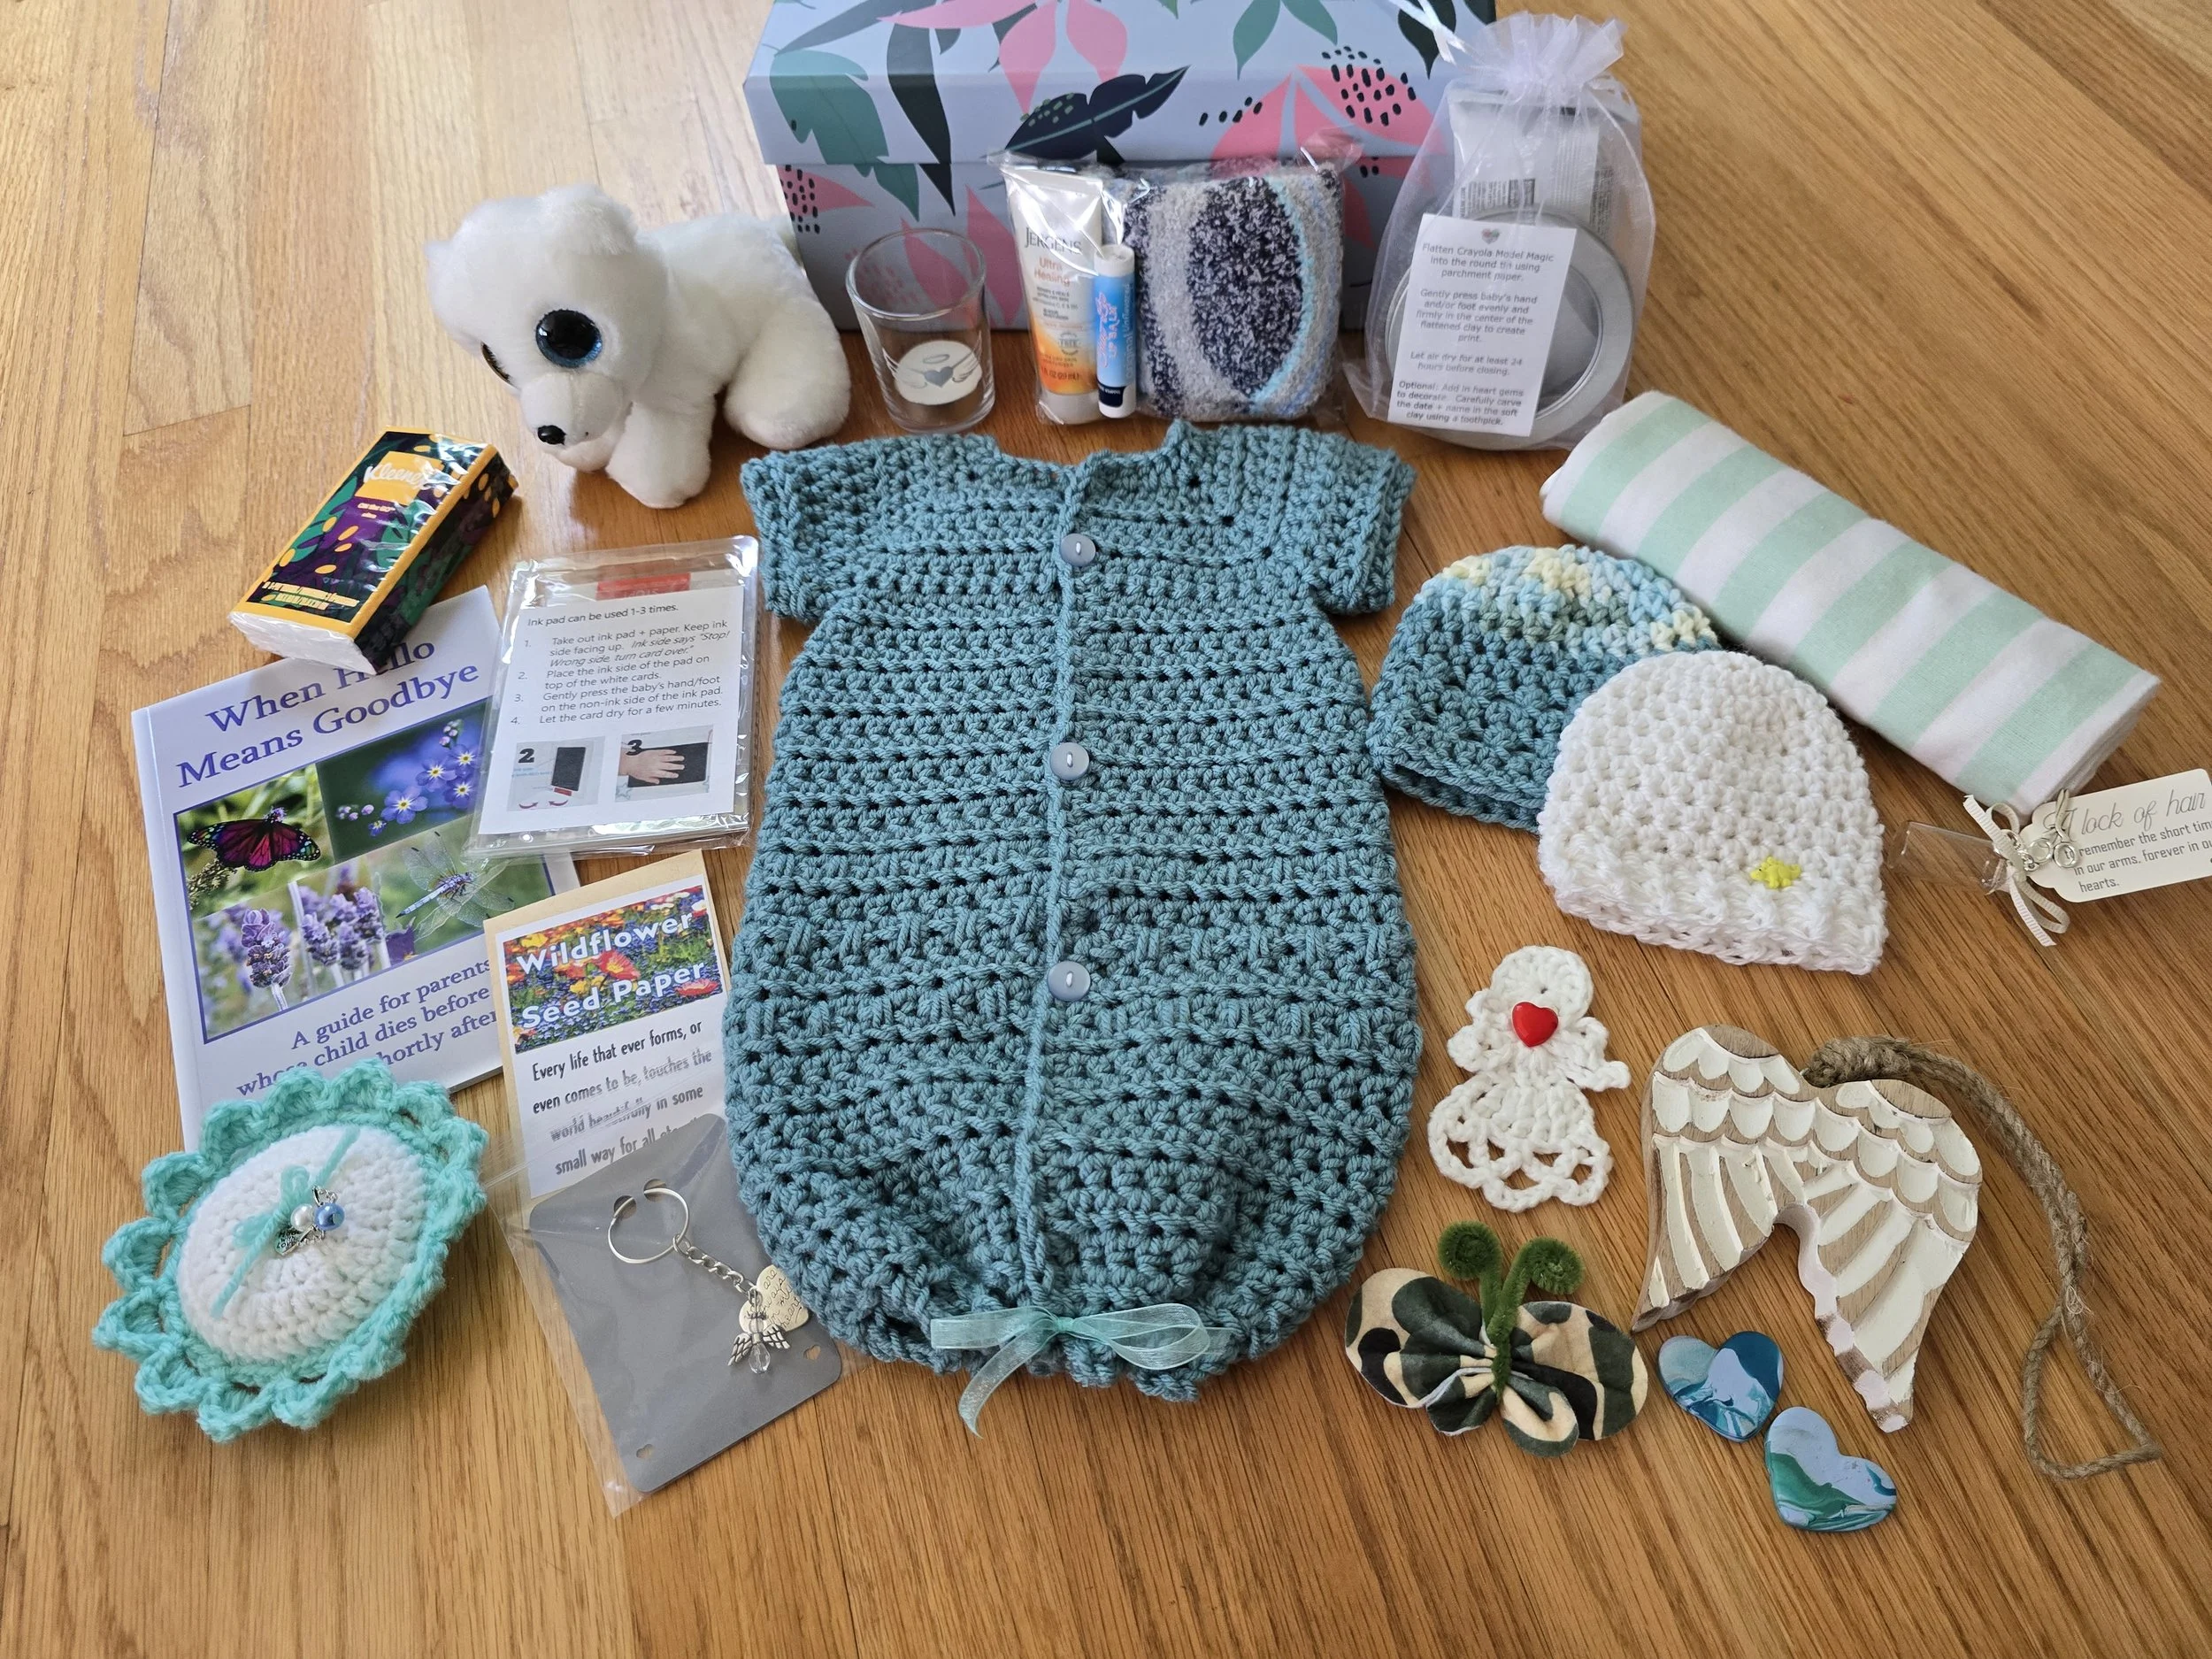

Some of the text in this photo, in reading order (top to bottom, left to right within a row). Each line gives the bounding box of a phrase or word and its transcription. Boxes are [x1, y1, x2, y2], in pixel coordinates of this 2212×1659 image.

[1422, 243, 1554, 263] Flatten Crayola Magic
[1441, 269, 1491, 280] parchment
[1516, 264, 1540, 273] using
[1420, 289, 1538, 304] Gently press hand
[1479, 304, 1509, 313] evenly
[1421, 320, 1525, 334] flattened clay create
[1417, 362, 1509, 376] hours before closing.
[1486, 356, 1508, 365] least
[1399, 380, 1439, 391] Optional:
[1473, 385, 1497, 395] heart
[1414, 402, 1432, 411] date
[1455, 395, 1494, 405] Carefully
[1407, 411, 1503, 426] clay using toothpick.
[527, 617, 543, 626] Ink
[546, 615, 566, 626] pad
[568, 614, 586, 623] can
[604, 609, 628, 618] used
[631, 607, 647, 616] 1-3
[649, 604, 679, 613] times.
[552, 635, 575, 645] Take
[578, 634, 595, 644] out
[597, 632, 613, 641] ink
[616, 630, 635, 641] pad
[649, 626, 681, 637] paper.
[684, 623, 710, 633] Keep
[549, 635, 695, 657] side facing Ink says
[547, 670, 574, 679] Place
[578, 667, 595, 676] the
[597, 665, 612, 674] ink
[616, 664, 637, 672] side
[654, 659, 670, 669] the
[672, 657, 693, 667] pad
[550, 649, 664, 668] Wrong card
[205, 641, 434, 732] When Hllo
[543, 676, 720, 702] Gently press the baby's hand/foot
[545, 682, 564, 691] top
[580, 678, 595, 687] the
[600, 675, 629, 685] white
[631, 672, 661, 682] cards.
[559, 703, 576, 711] the
[580, 699, 619, 709] non-ink
[624, 696, 645, 705] side
[682, 689, 697, 699] ink
[701, 687, 723, 699] pad.
[540, 699, 721, 724] Let the card dry for few minutes.
[175, 665, 480, 787] Means Goodbye
[518, 749, 534, 763] 2
[626, 740, 642, 756] 3
[2081, 803, 2123, 834] lock
[2134, 801, 2157, 832] of
[2166, 789, 2205, 817] hair
[2079, 838, 2135, 856] remember
[2139, 831, 2157, 845] the
[2161, 825, 2190, 840] short
[2193, 821, 2212, 833] tim
[2087, 862, 2105, 873] our
[2143, 846, 2185, 862] forever
[2189, 841, 2200, 852] in
[2078, 876, 2119, 892] hearts.
[516, 912, 693, 974] Wildflower
[291, 959, 490, 1049] A guide for parents
[522, 987, 600, 1028] Seed
[314, 1032, 370, 1066] child
[375, 1017, 417, 1042] dies
[420, 987, 490, 1022] before
[376, 1033, 445, 1065] hortly
[533, 1021, 702, 1080] Every life that ever forms, or
[533, 1047, 712, 1114] even comes to be, touches the
[550, 1113, 584, 1142] world
[657, 1098, 667, 1110] in
[672, 1087, 703, 1106] some
[556, 1128, 656, 1175] small way for all
